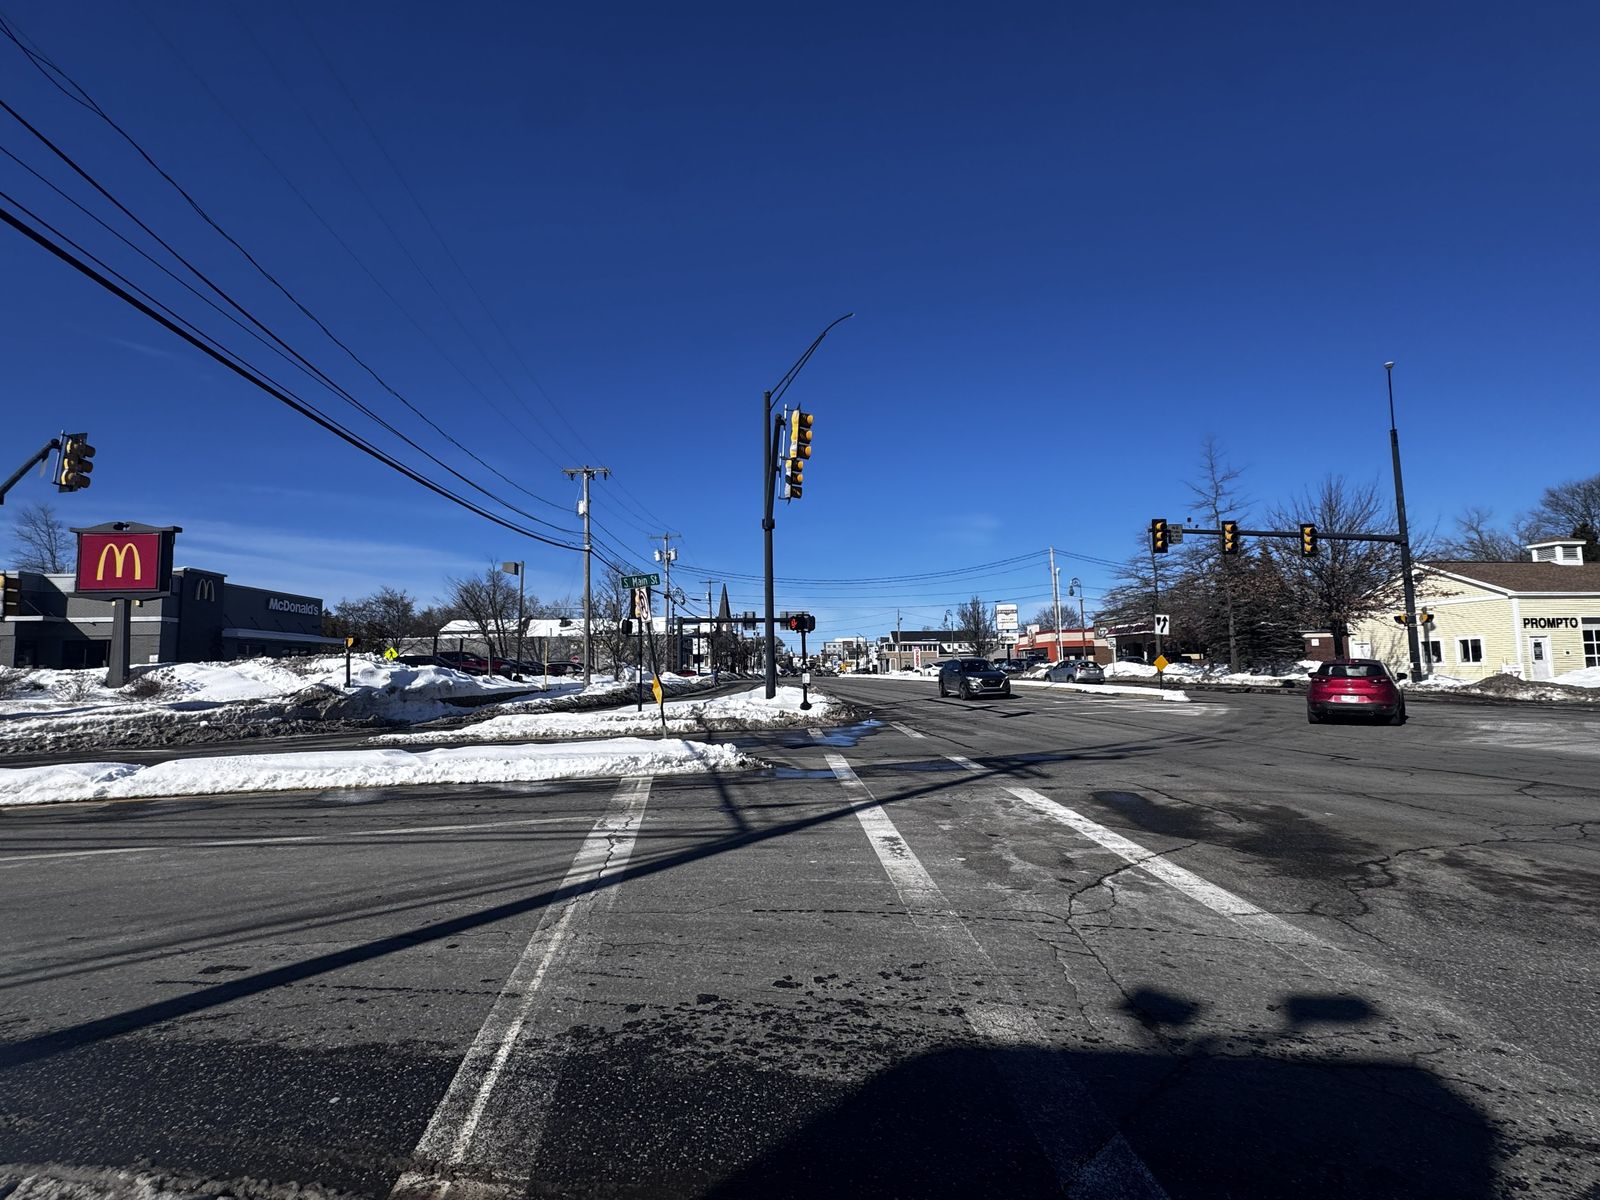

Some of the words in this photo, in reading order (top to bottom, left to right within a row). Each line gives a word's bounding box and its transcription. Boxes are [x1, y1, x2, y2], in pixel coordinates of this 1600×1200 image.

[632, 577, 648, 587] Main
[650, 575, 658, 585] St
[268, 598, 319, 616] McDonald's
[1523, 617, 1578, 629] PROMPTO
